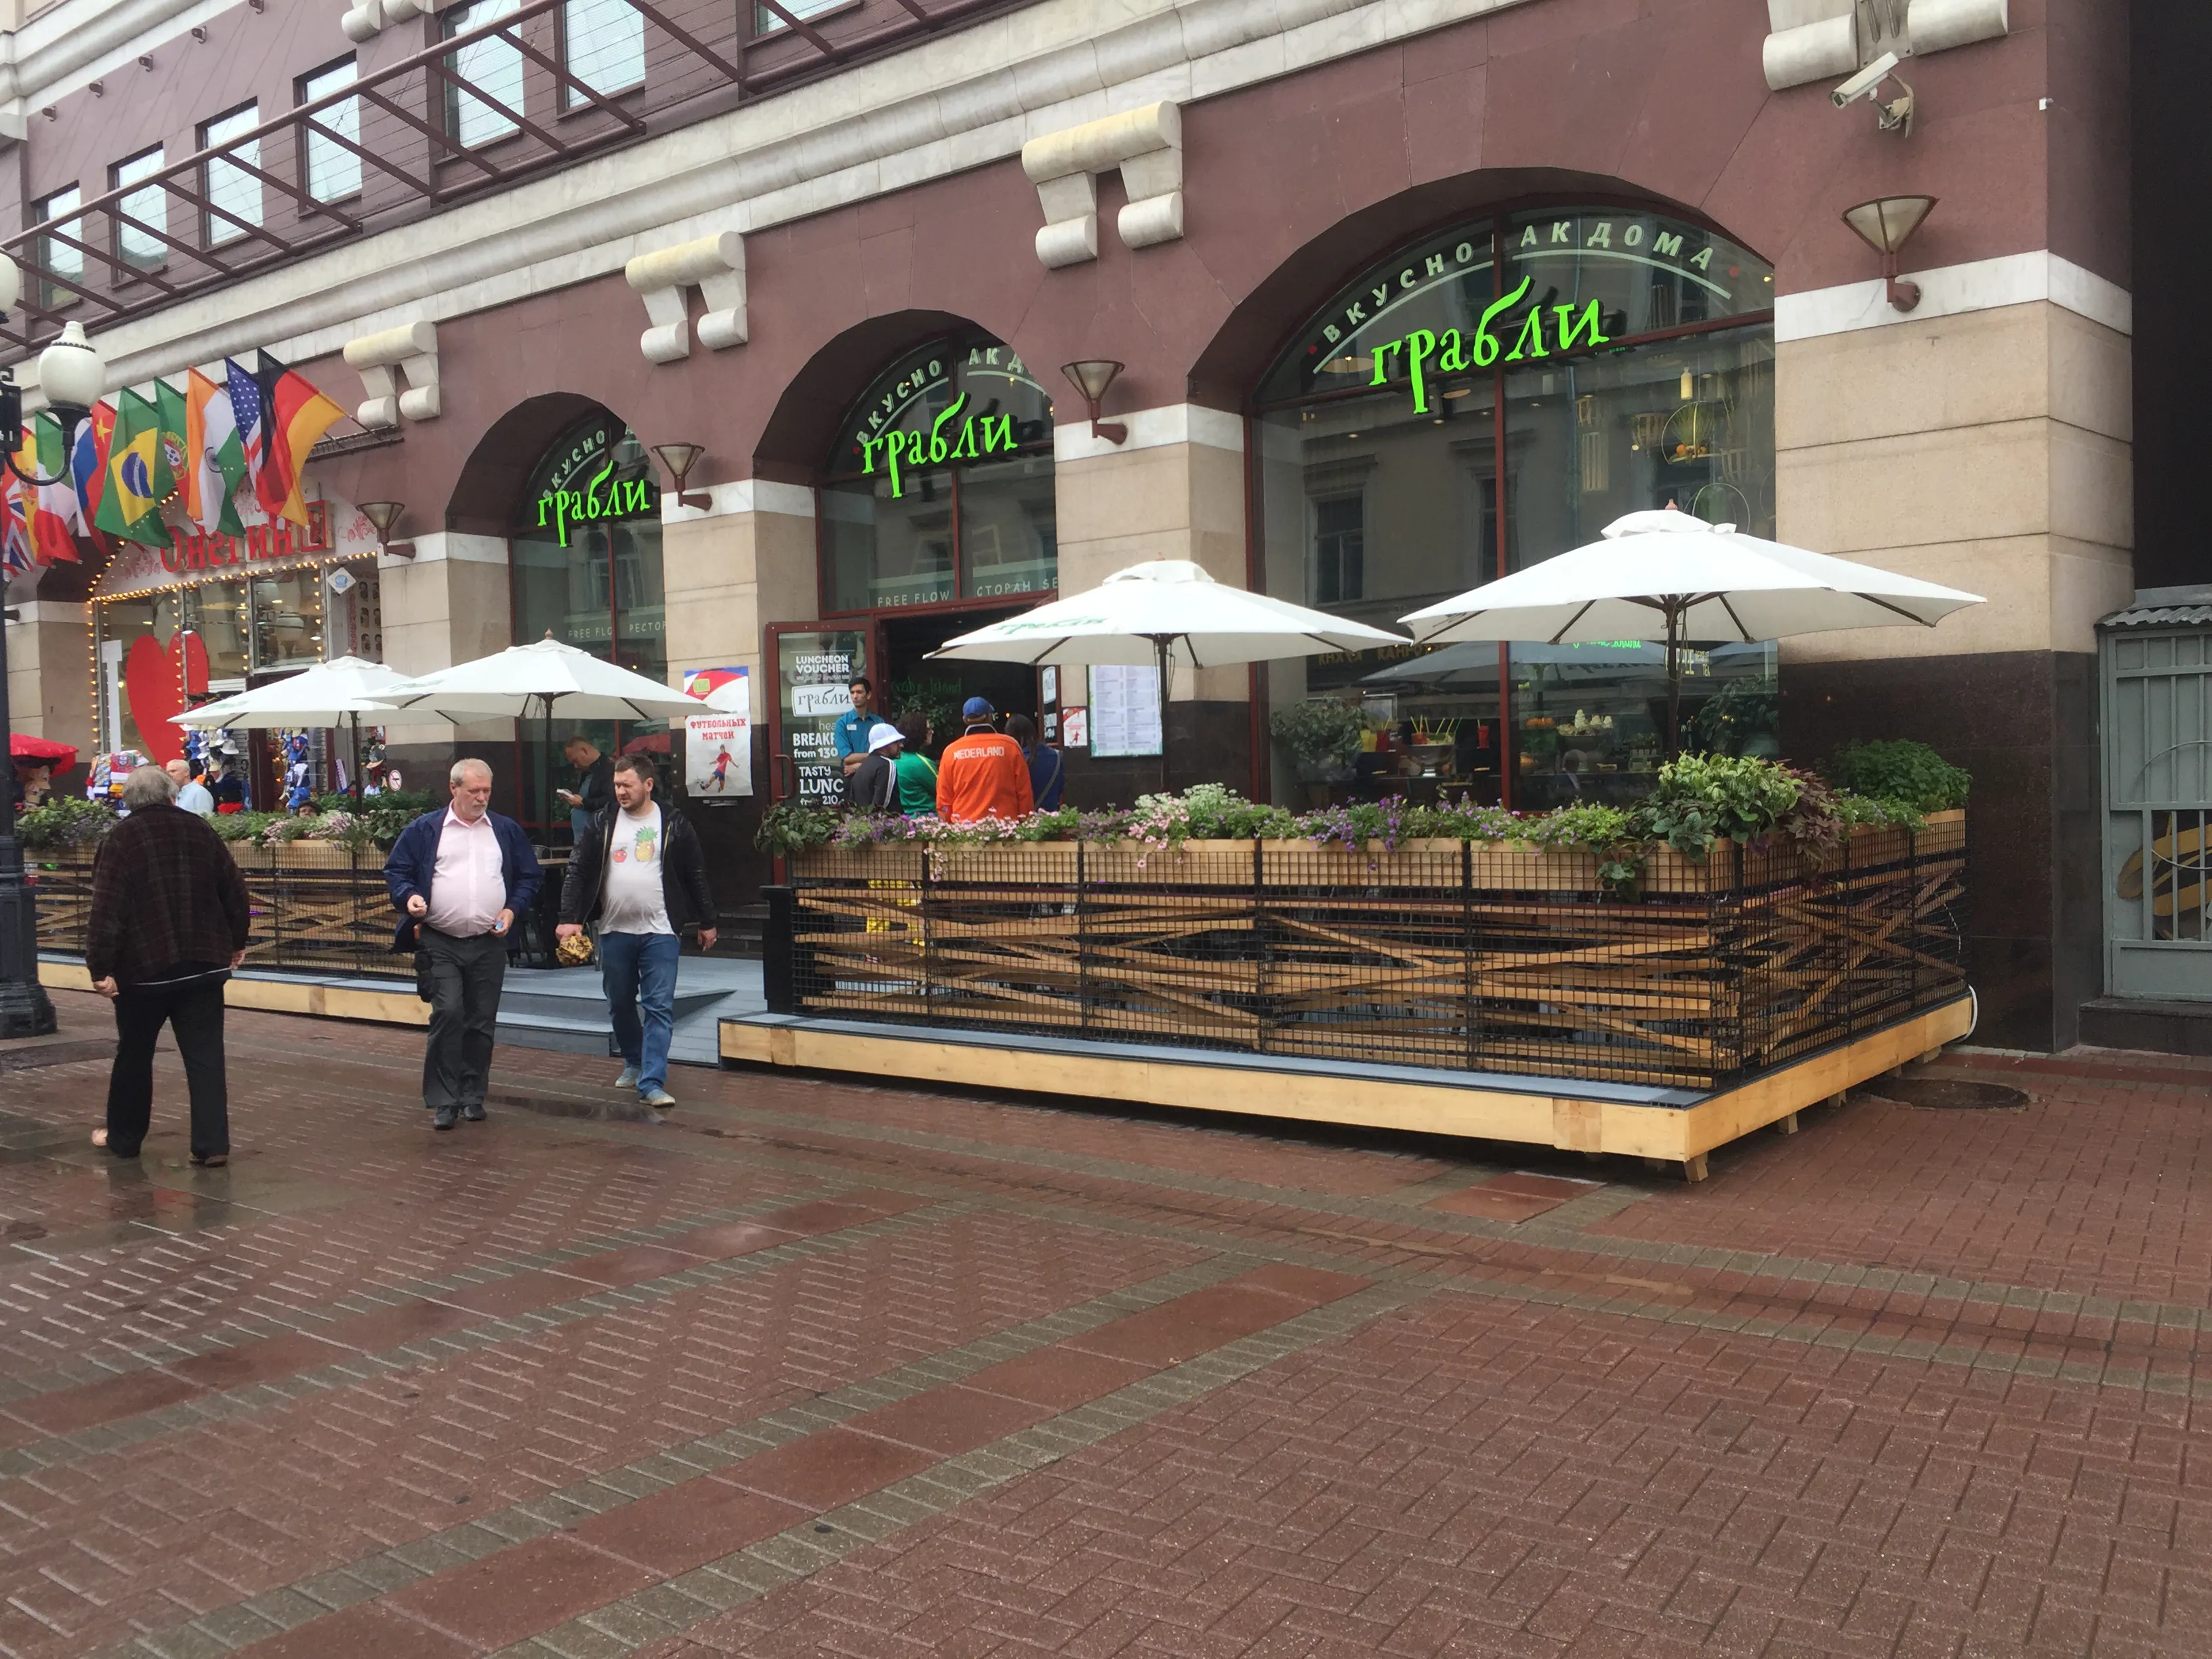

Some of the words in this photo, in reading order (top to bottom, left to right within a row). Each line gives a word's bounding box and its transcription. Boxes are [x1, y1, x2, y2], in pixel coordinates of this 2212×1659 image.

[1323, 242, 1474, 344] ВКУСНО
[1369, 275, 1609, 413] грабли
[862, 391, 1018, 497] грабли
[537, 459, 651, 548] грабли
[878, 594, 907, 607] FREE
[915, 590, 949, 604] FLOW
[568, 628, 590, 638] FREE
[796, 655, 848, 664] LUNCHEON
[796, 663, 849, 674] VOUCHER
[798, 687, 851, 713] грабли
[794, 748, 816, 758] from
[818, 747, 838, 758] 130
[954, 746, 1004, 760] NEDERLAND
[799, 766, 832, 777] TASTY
[822, 795, 838, 805] 210
